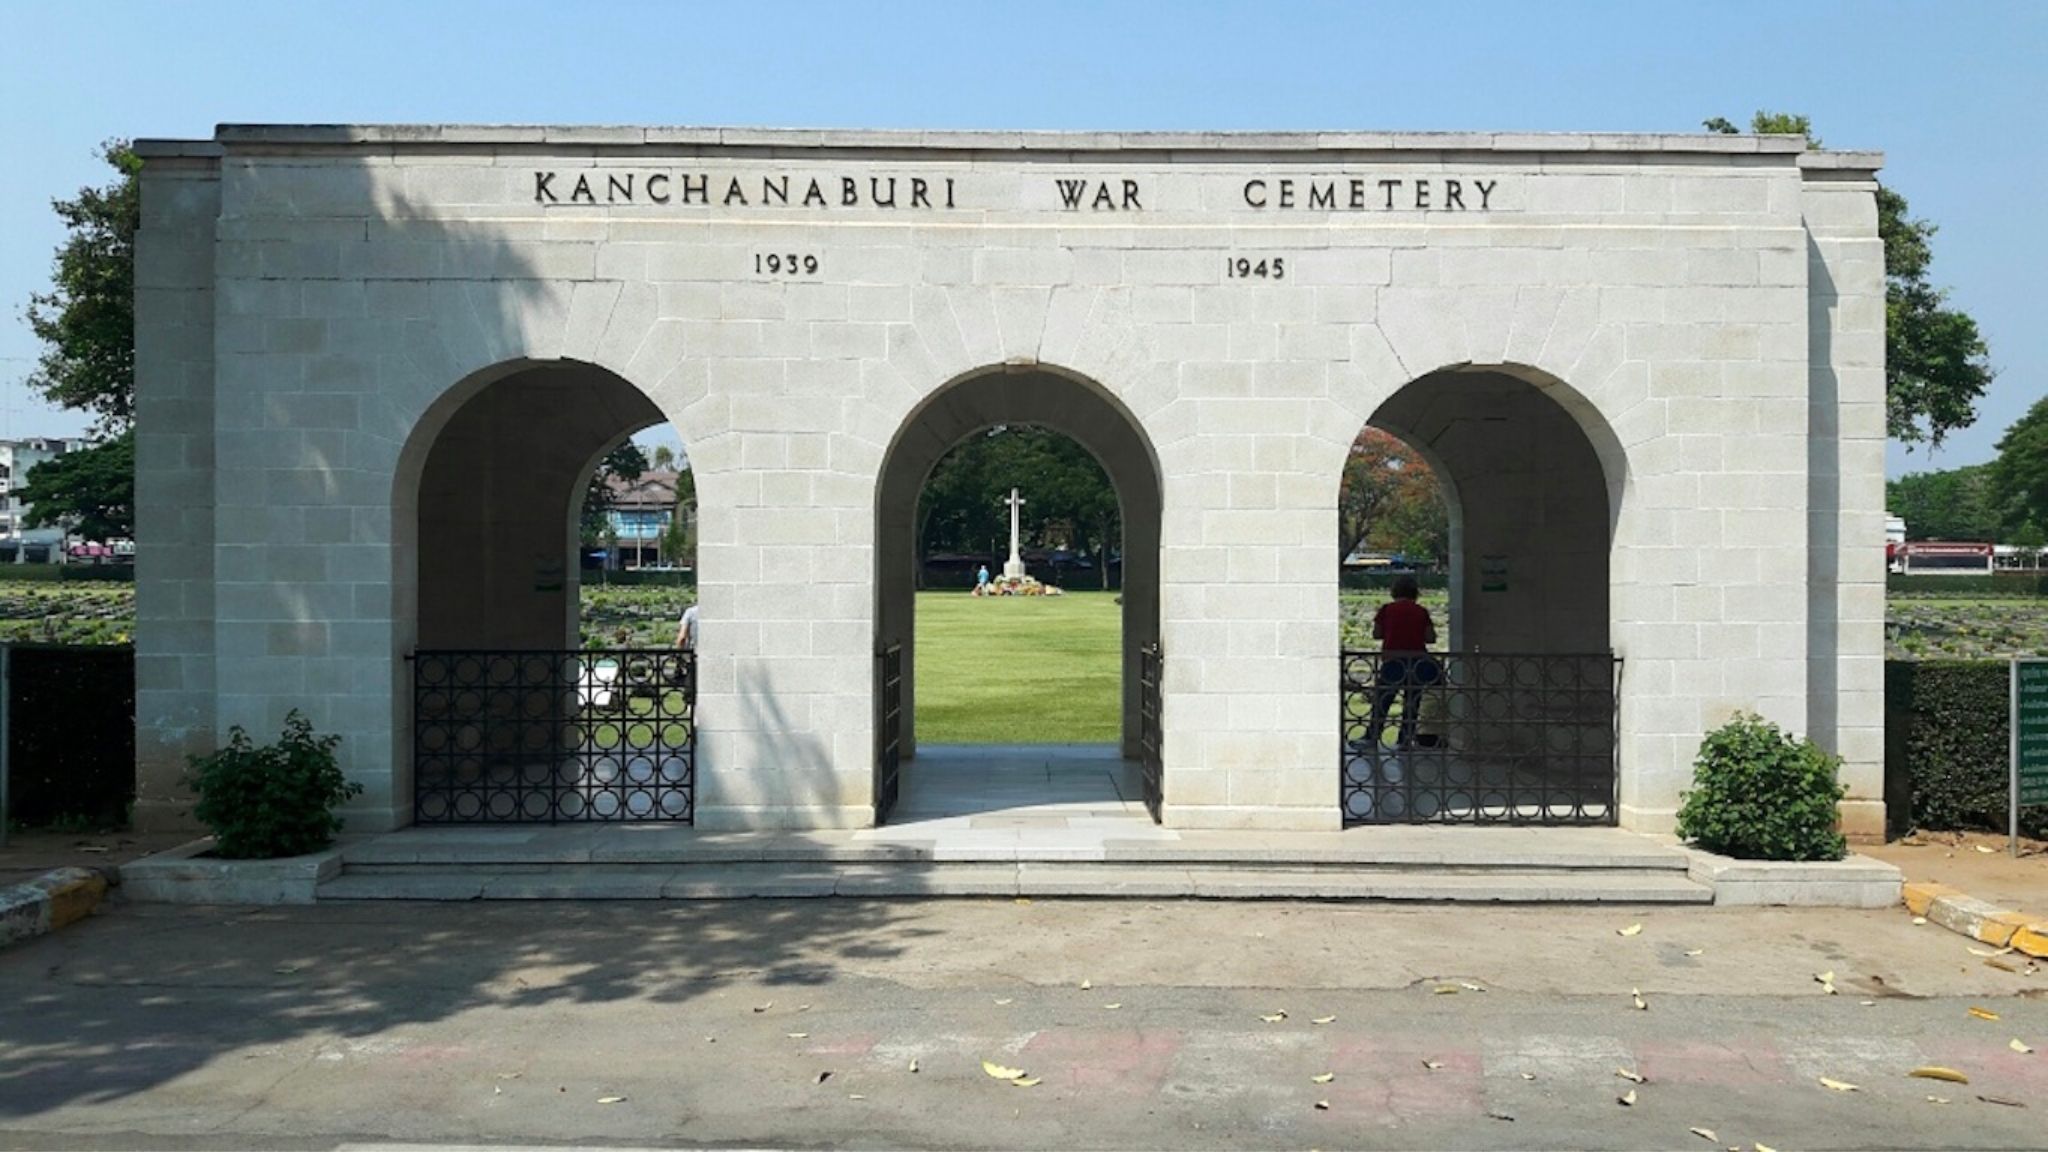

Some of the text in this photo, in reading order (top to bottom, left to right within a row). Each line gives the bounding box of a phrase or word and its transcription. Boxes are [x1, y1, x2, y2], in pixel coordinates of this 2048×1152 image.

[534, 171, 1499, 210] KANCHANABURI WAR CEMETERY
[754, 252, 819, 275] 1939
[1227, 257, 1286, 279] 1945
